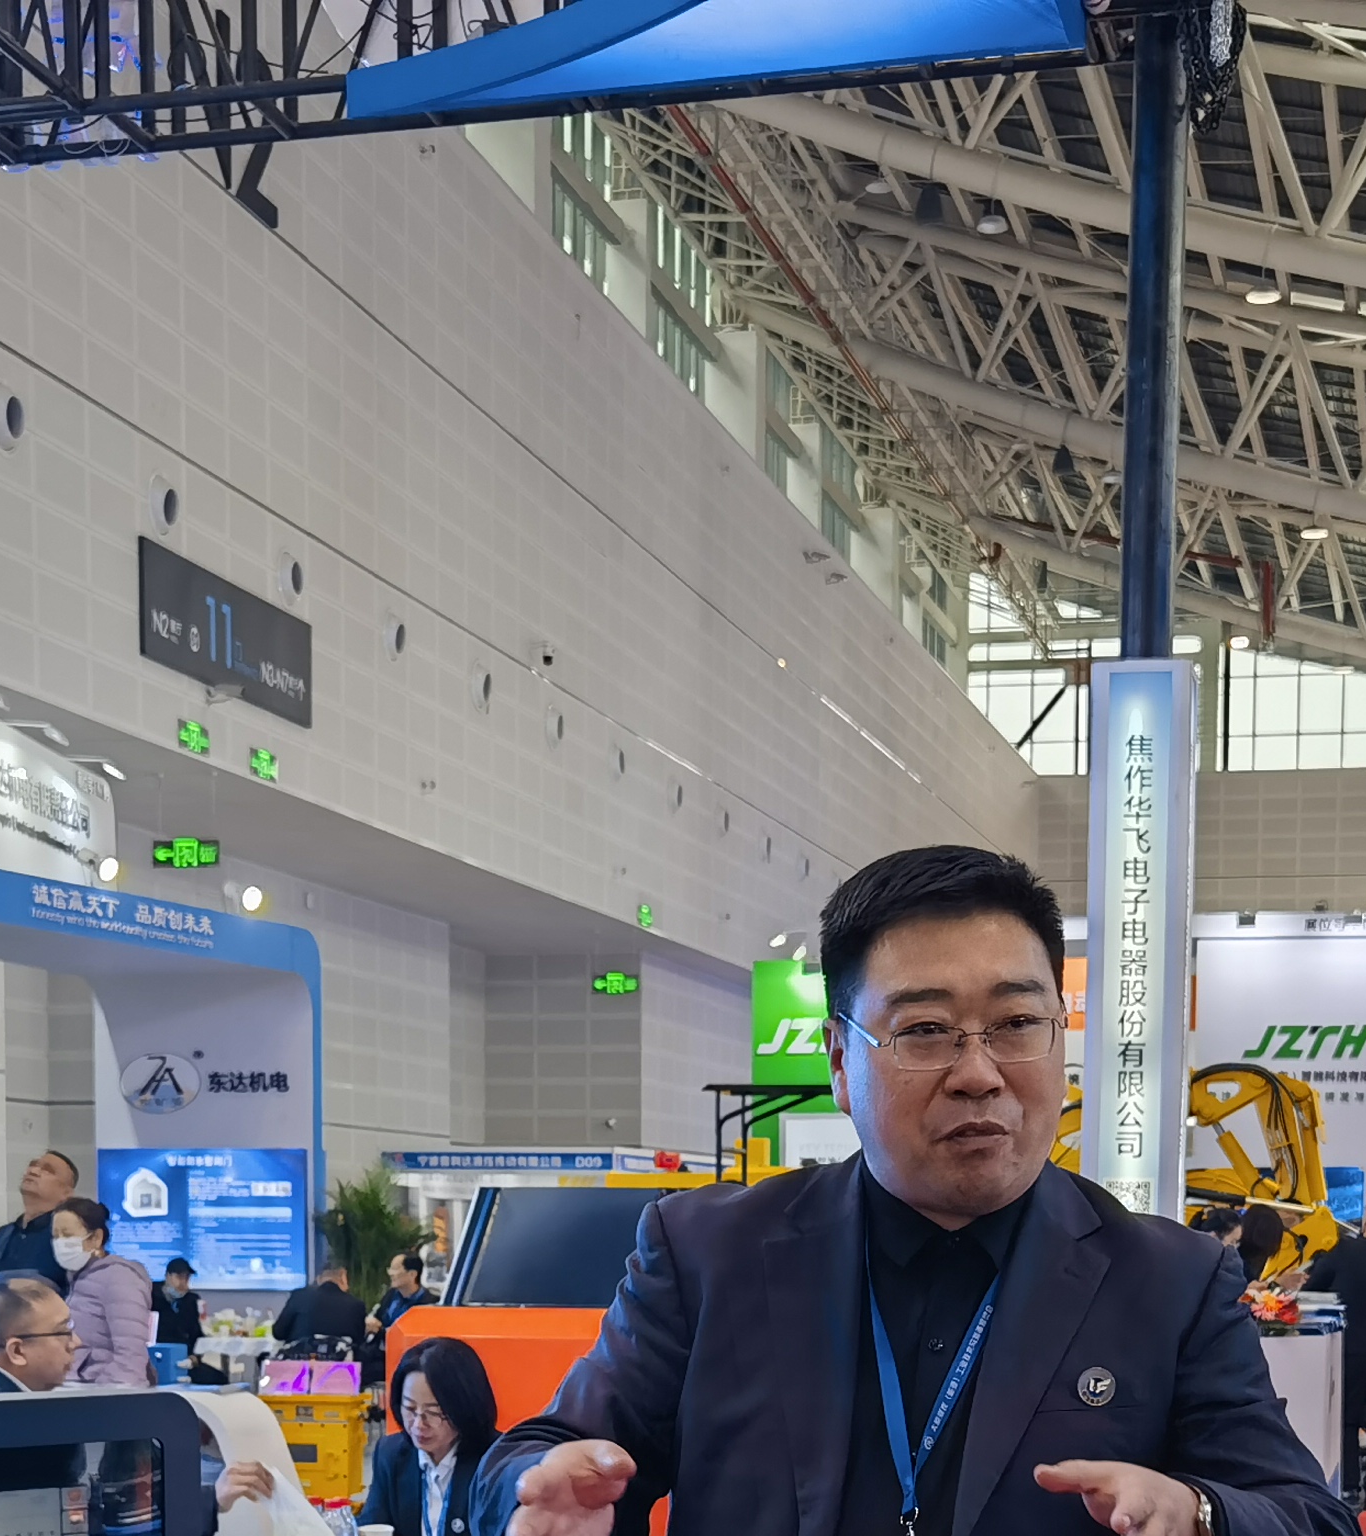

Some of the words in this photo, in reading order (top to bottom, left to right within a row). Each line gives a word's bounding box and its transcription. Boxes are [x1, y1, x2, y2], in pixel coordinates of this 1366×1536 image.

[206, 596, 233, 669] 11
[32, 884, 121, 919] 诚信赢天下
[135, 904, 215, 937] 品质创未来
[1115, 734, 1154, 1159] 焦作华飞电子电器股份有限公司
[756, 1017, 827, 1055] JZ
[208, 1071, 290, 1094] 东达机电
